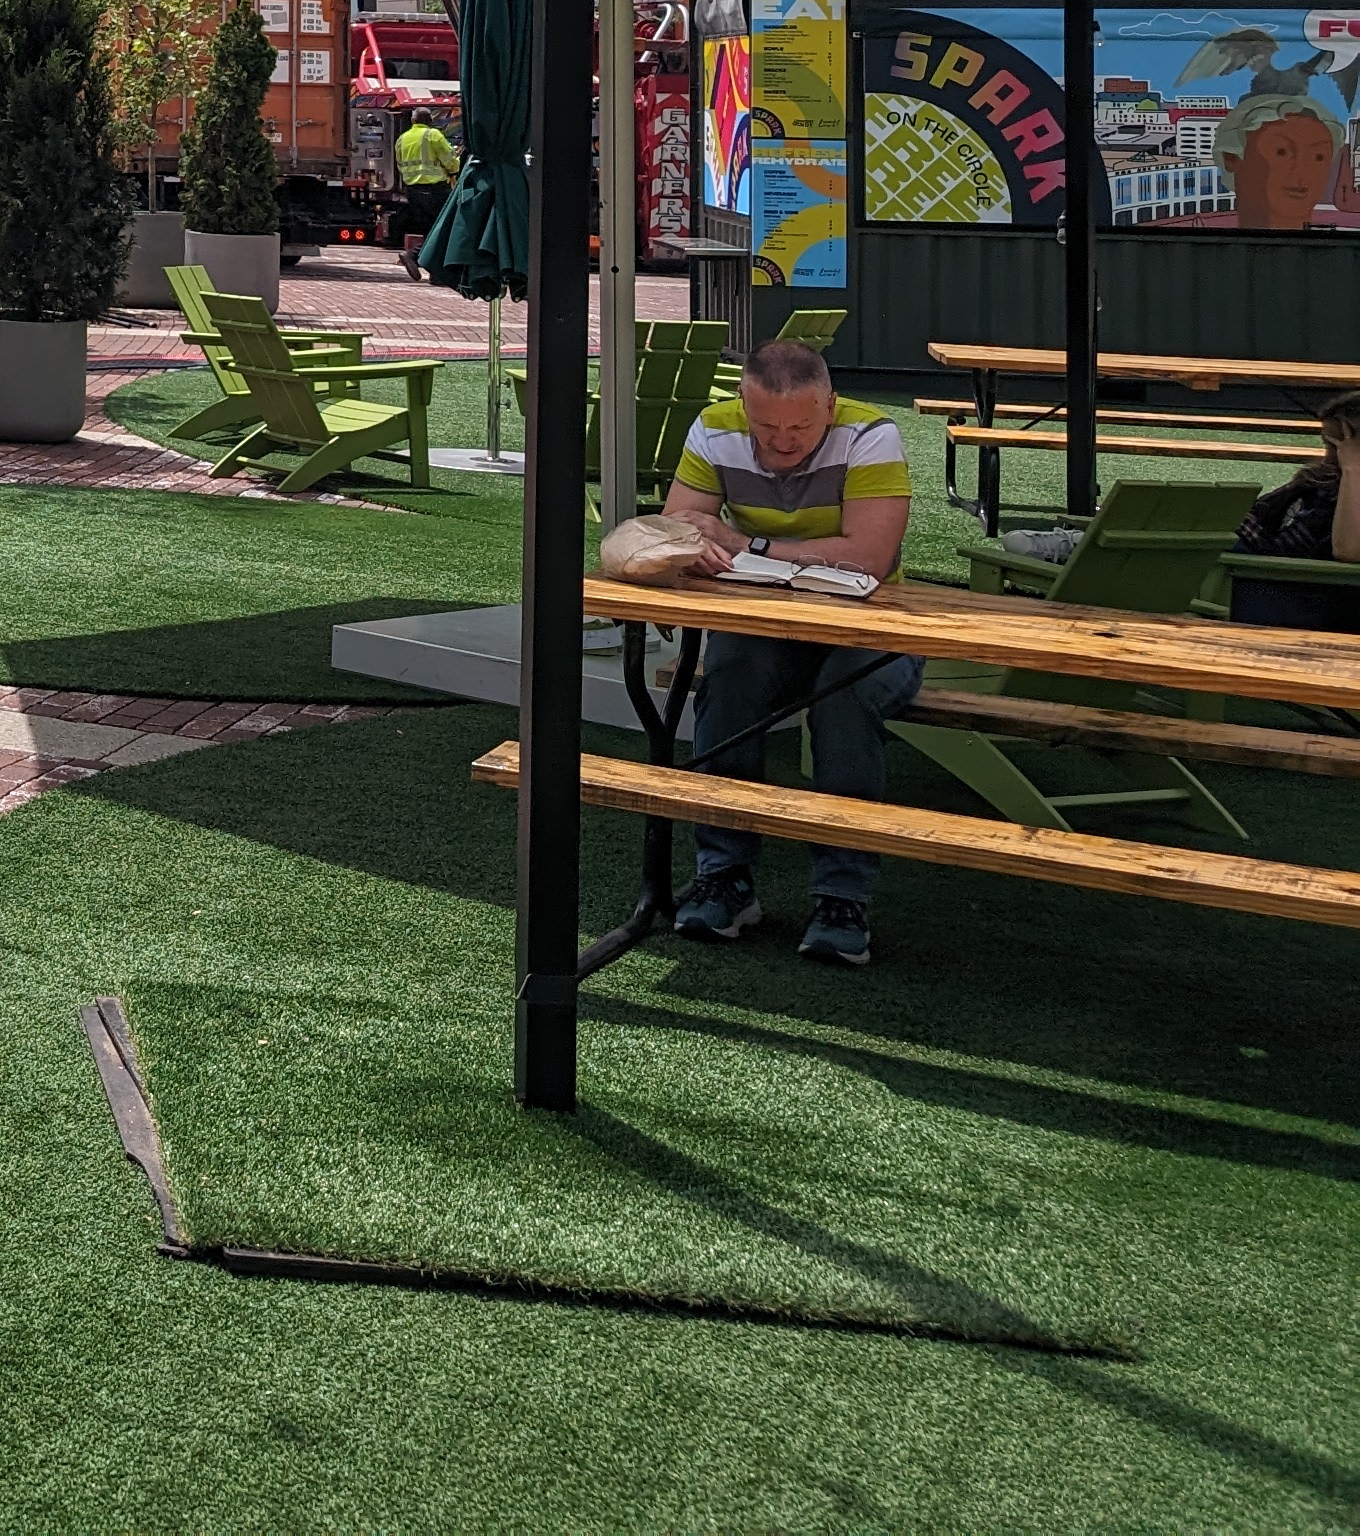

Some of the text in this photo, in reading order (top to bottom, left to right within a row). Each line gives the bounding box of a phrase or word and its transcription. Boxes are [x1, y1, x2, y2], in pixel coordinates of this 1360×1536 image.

[754, 109, 782, 136] SPARK
[890, 31, 1066, 204] SPARK
[658, 107, 689, 233] GARNERS
[752, 157, 846, 166] REHYDRATE
[886, 111, 918, 127] ON
[924, 116, 960, 146] THE
[957, 143, 991, 207] CIRCLE
[755, 258, 783, 284] SPARK
